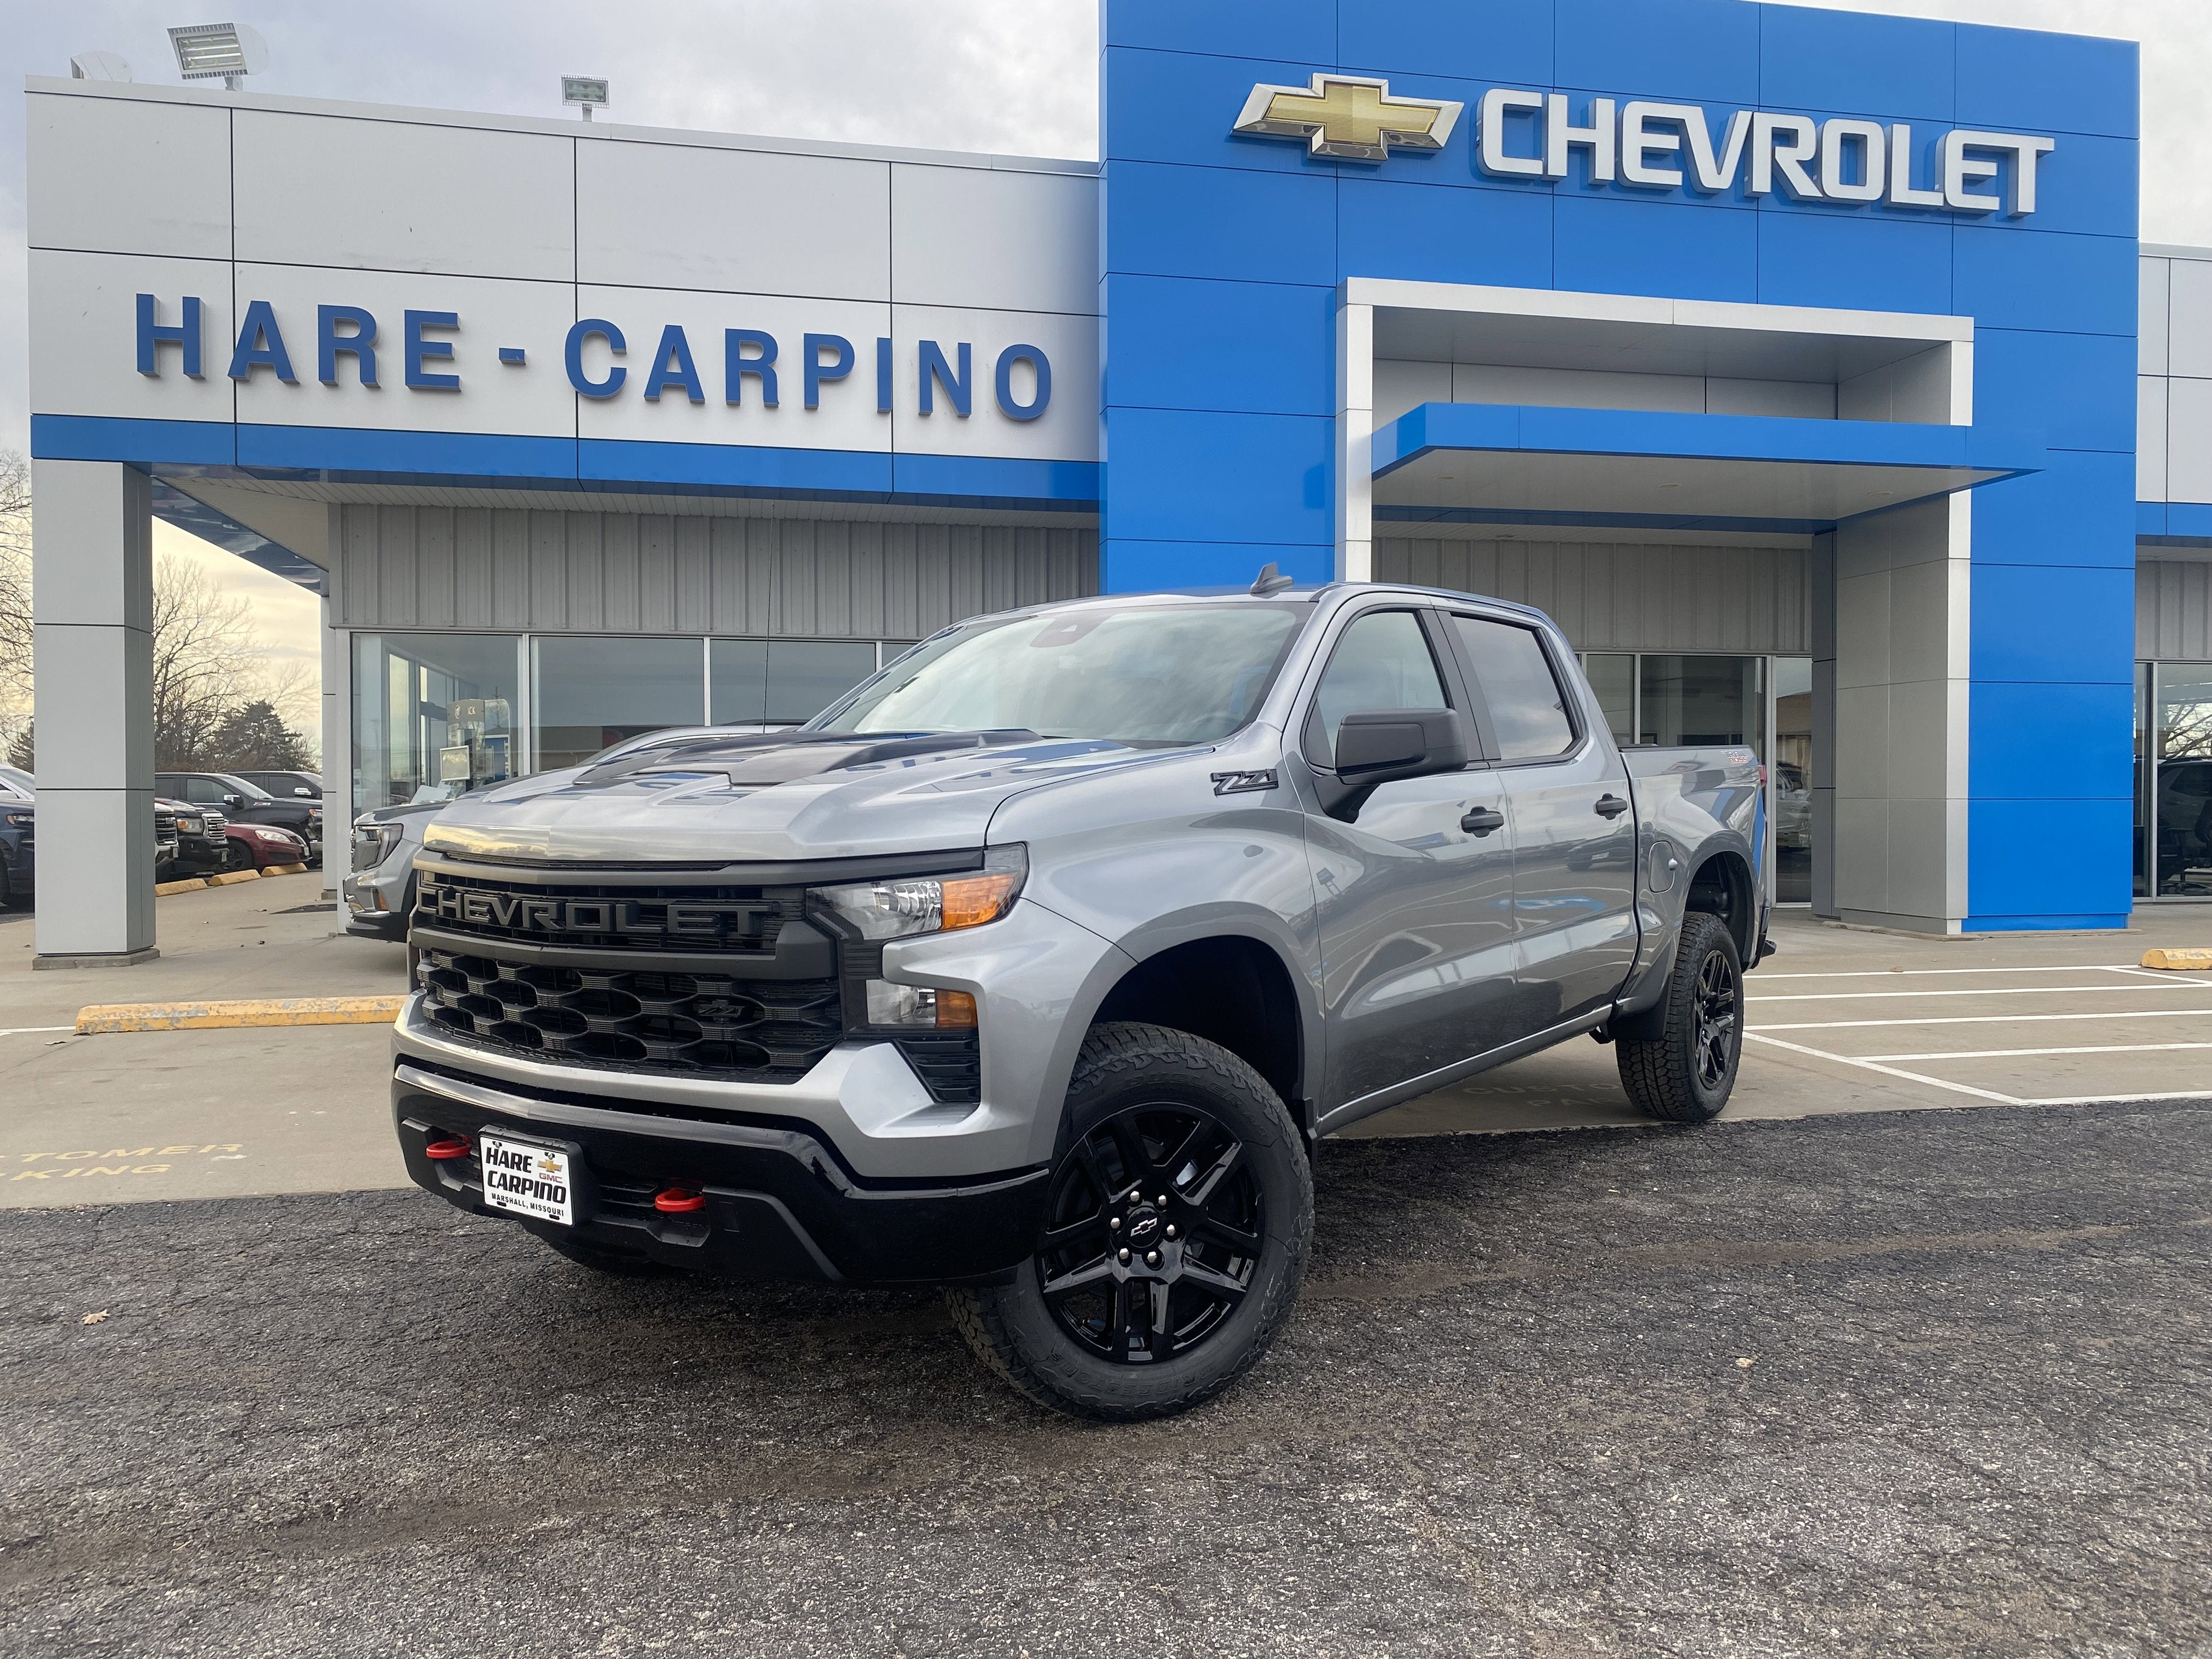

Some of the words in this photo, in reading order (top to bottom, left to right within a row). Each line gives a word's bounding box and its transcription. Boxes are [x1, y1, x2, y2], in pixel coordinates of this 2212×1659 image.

[1477, 88, 2055, 218] CHEVROLET
[136, 293, 462, 392] HARE
[565, 319, 1052, 422] CARPINO
[417, 884, 779, 935] CHEVROLET
[1463, 1082, 1620, 1094] CUSTO
[0, 1144, 244, 1162] TOMER
[486, 1147, 533, 1173] HARE
[0, 1164, 171, 1181] KING
[539, 1172, 562, 1183] GMC
[487, 1170, 566, 1204] CARPINO
[492, 1193, 528, 1209] MARSHALL,
[530, 1202, 564, 1217] MISSOURI
